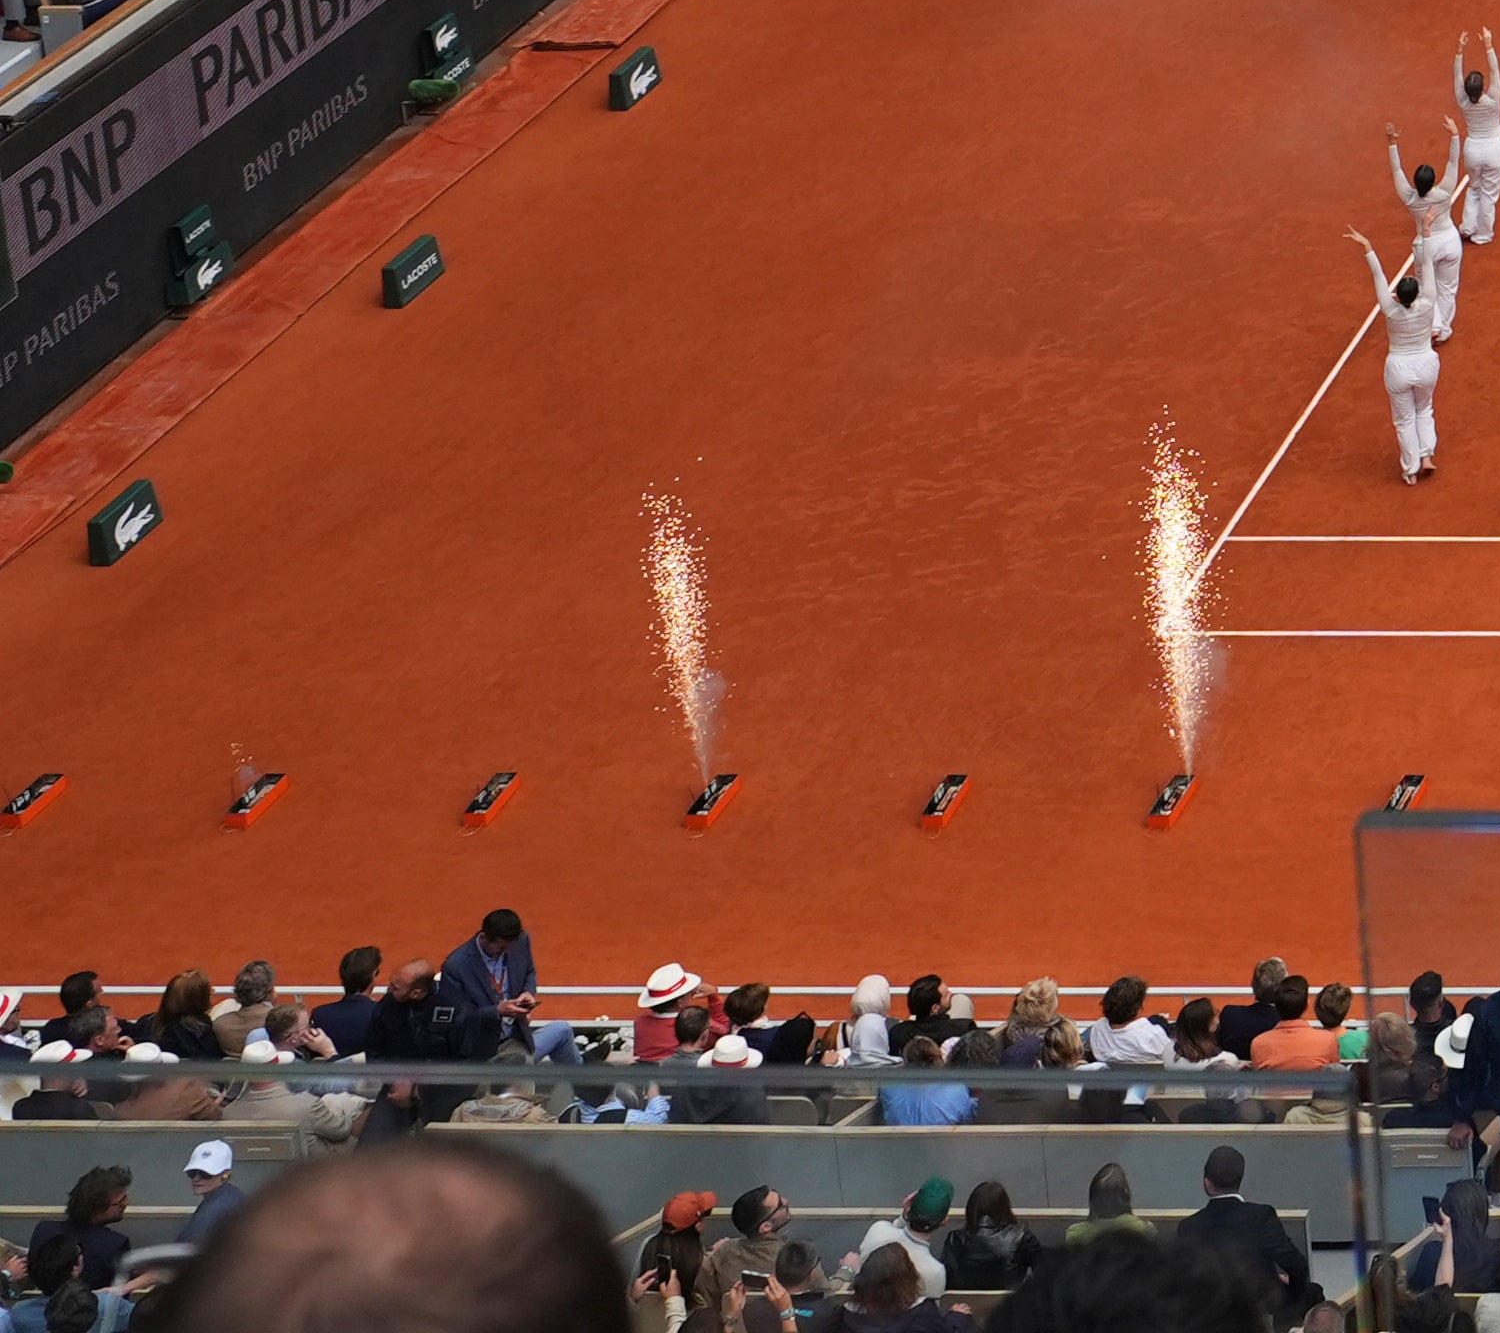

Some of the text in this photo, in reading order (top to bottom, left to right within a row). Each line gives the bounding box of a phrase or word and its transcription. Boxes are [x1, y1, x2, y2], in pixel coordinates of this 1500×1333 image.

[443, 56, 471, 81] COSTE
[242, 73, 369, 193] BNP PARIBAS
[19, 107, 137, 257] BNP
[185, 218, 212, 244] LACOSTE
[400, 252, 439, 290] LACOSTE
[23, 269, 120, 366] PARIBAS
